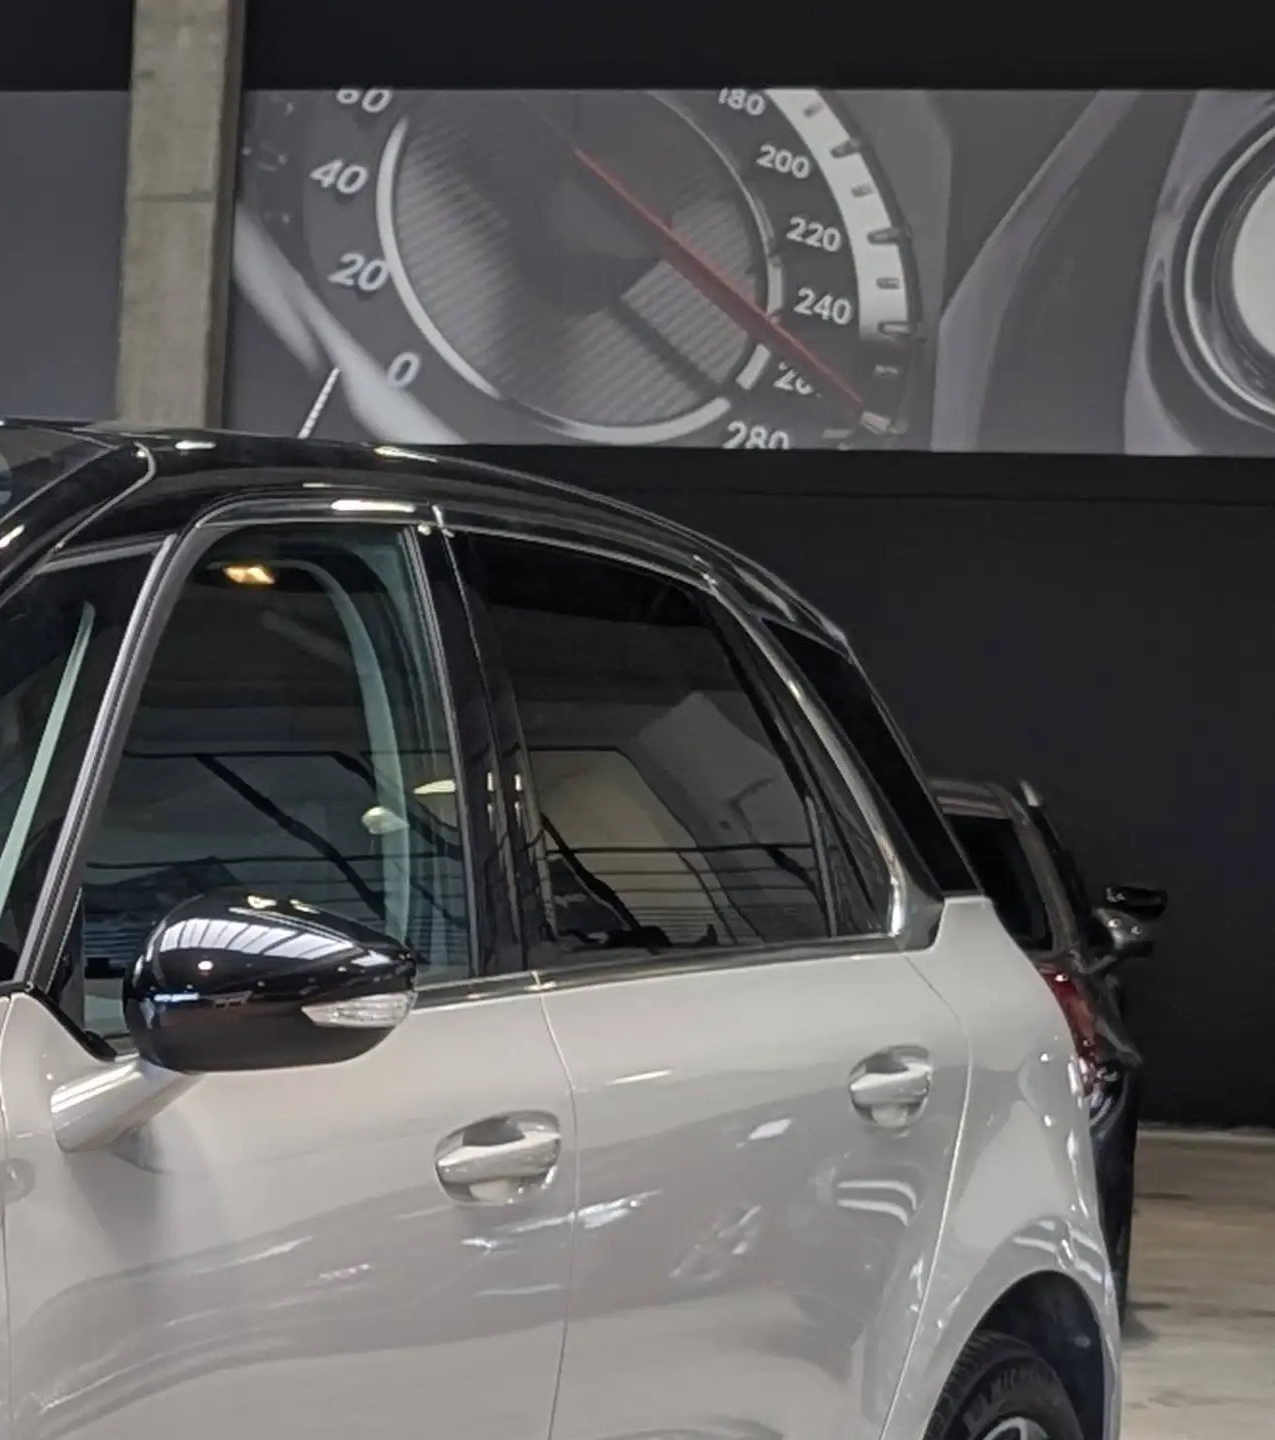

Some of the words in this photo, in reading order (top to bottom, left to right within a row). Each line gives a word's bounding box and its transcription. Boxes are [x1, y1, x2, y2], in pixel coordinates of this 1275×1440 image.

[309, 159, 368, 194] 40
[755, 143, 810, 179] 200
[786, 216, 841, 252] 220
[327, 252, 389, 291] 20
[793, 287, 851, 325] 240
[387, 351, 421, 388] 0
